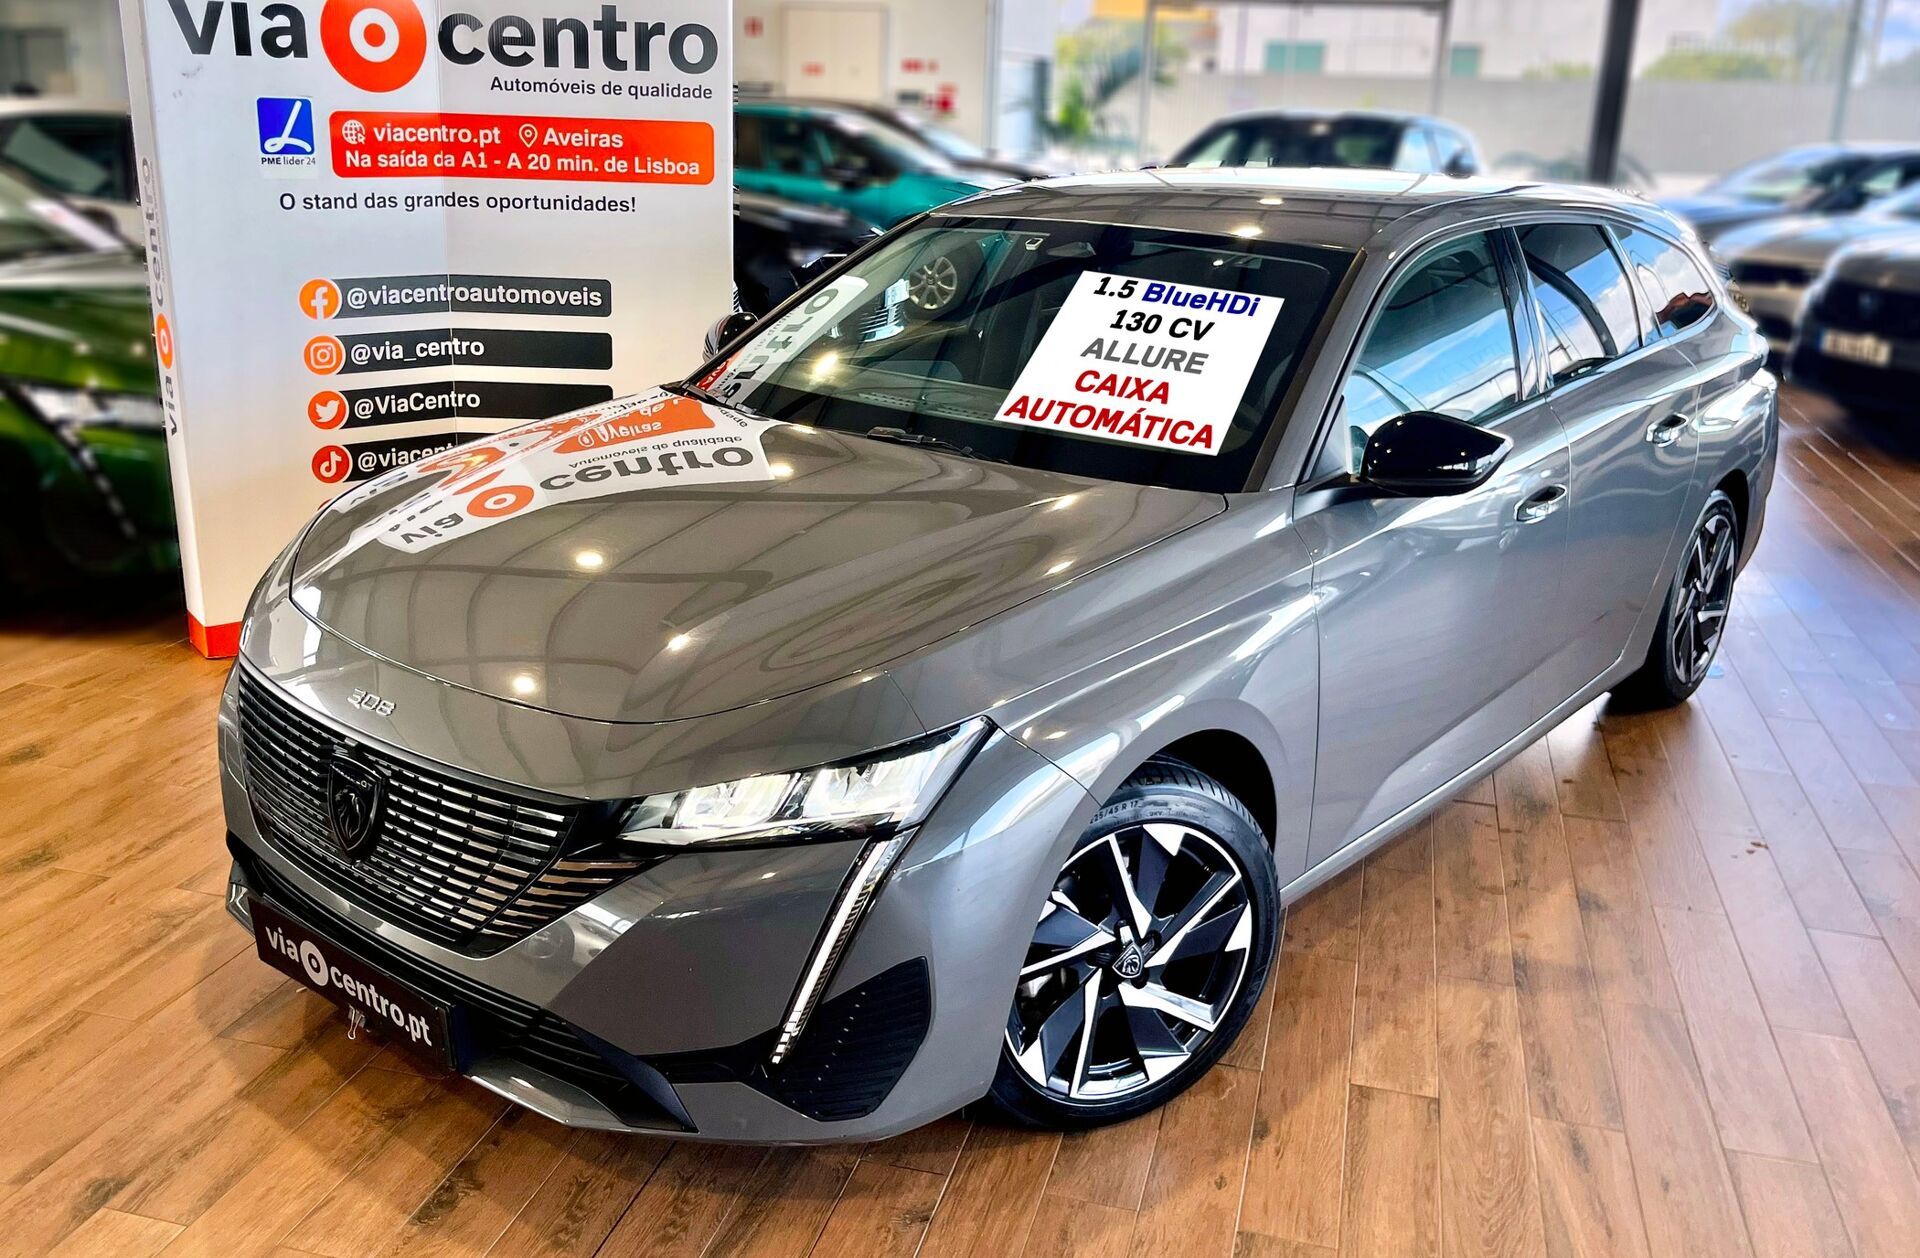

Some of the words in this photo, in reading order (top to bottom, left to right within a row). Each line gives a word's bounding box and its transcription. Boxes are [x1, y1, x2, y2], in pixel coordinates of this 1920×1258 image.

[168, 0, 309, 59] via
[438, 4, 718, 75] centro
[490, 76, 596, 96] Automóveis
[601, 81, 623, 96] de
[628, 83, 713, 100] qualidade
[373, 122, 501, 147] viacentro.pt
[543, 127, 624, 149] Aveiras
[261, 156, 282, 165] PME
[345, 150, 372, 168] Na
[377, 150, 428, 168] saída
[433, 150, 455, 168] da
[461, 151, 488, 169] A1
[507, 153, 522, 170] A
[527, 153, 551, 171] 20
[556, 154, 600, 172] min.
[604, 156, 628, 173] de
[634, 156, 700, 175] Lisboa
[279, 193, 296, 210] O
[303, 192, 358, 210] stand
[364, 192, 398, 209] das
[404, 191, 480, 212] grandes
[486, 194, 637, 213] oportunidades!
[346, 284, 603, 310] @viacentroautomoveis
[350, 337, 486, 366] @via_centro
[354, 390, 481, 419] @ViaCentro
[347, 688, 397, 716] 308
[265, 926, 300, 963] via
[330, 965, 433, 1047] centro.pt
